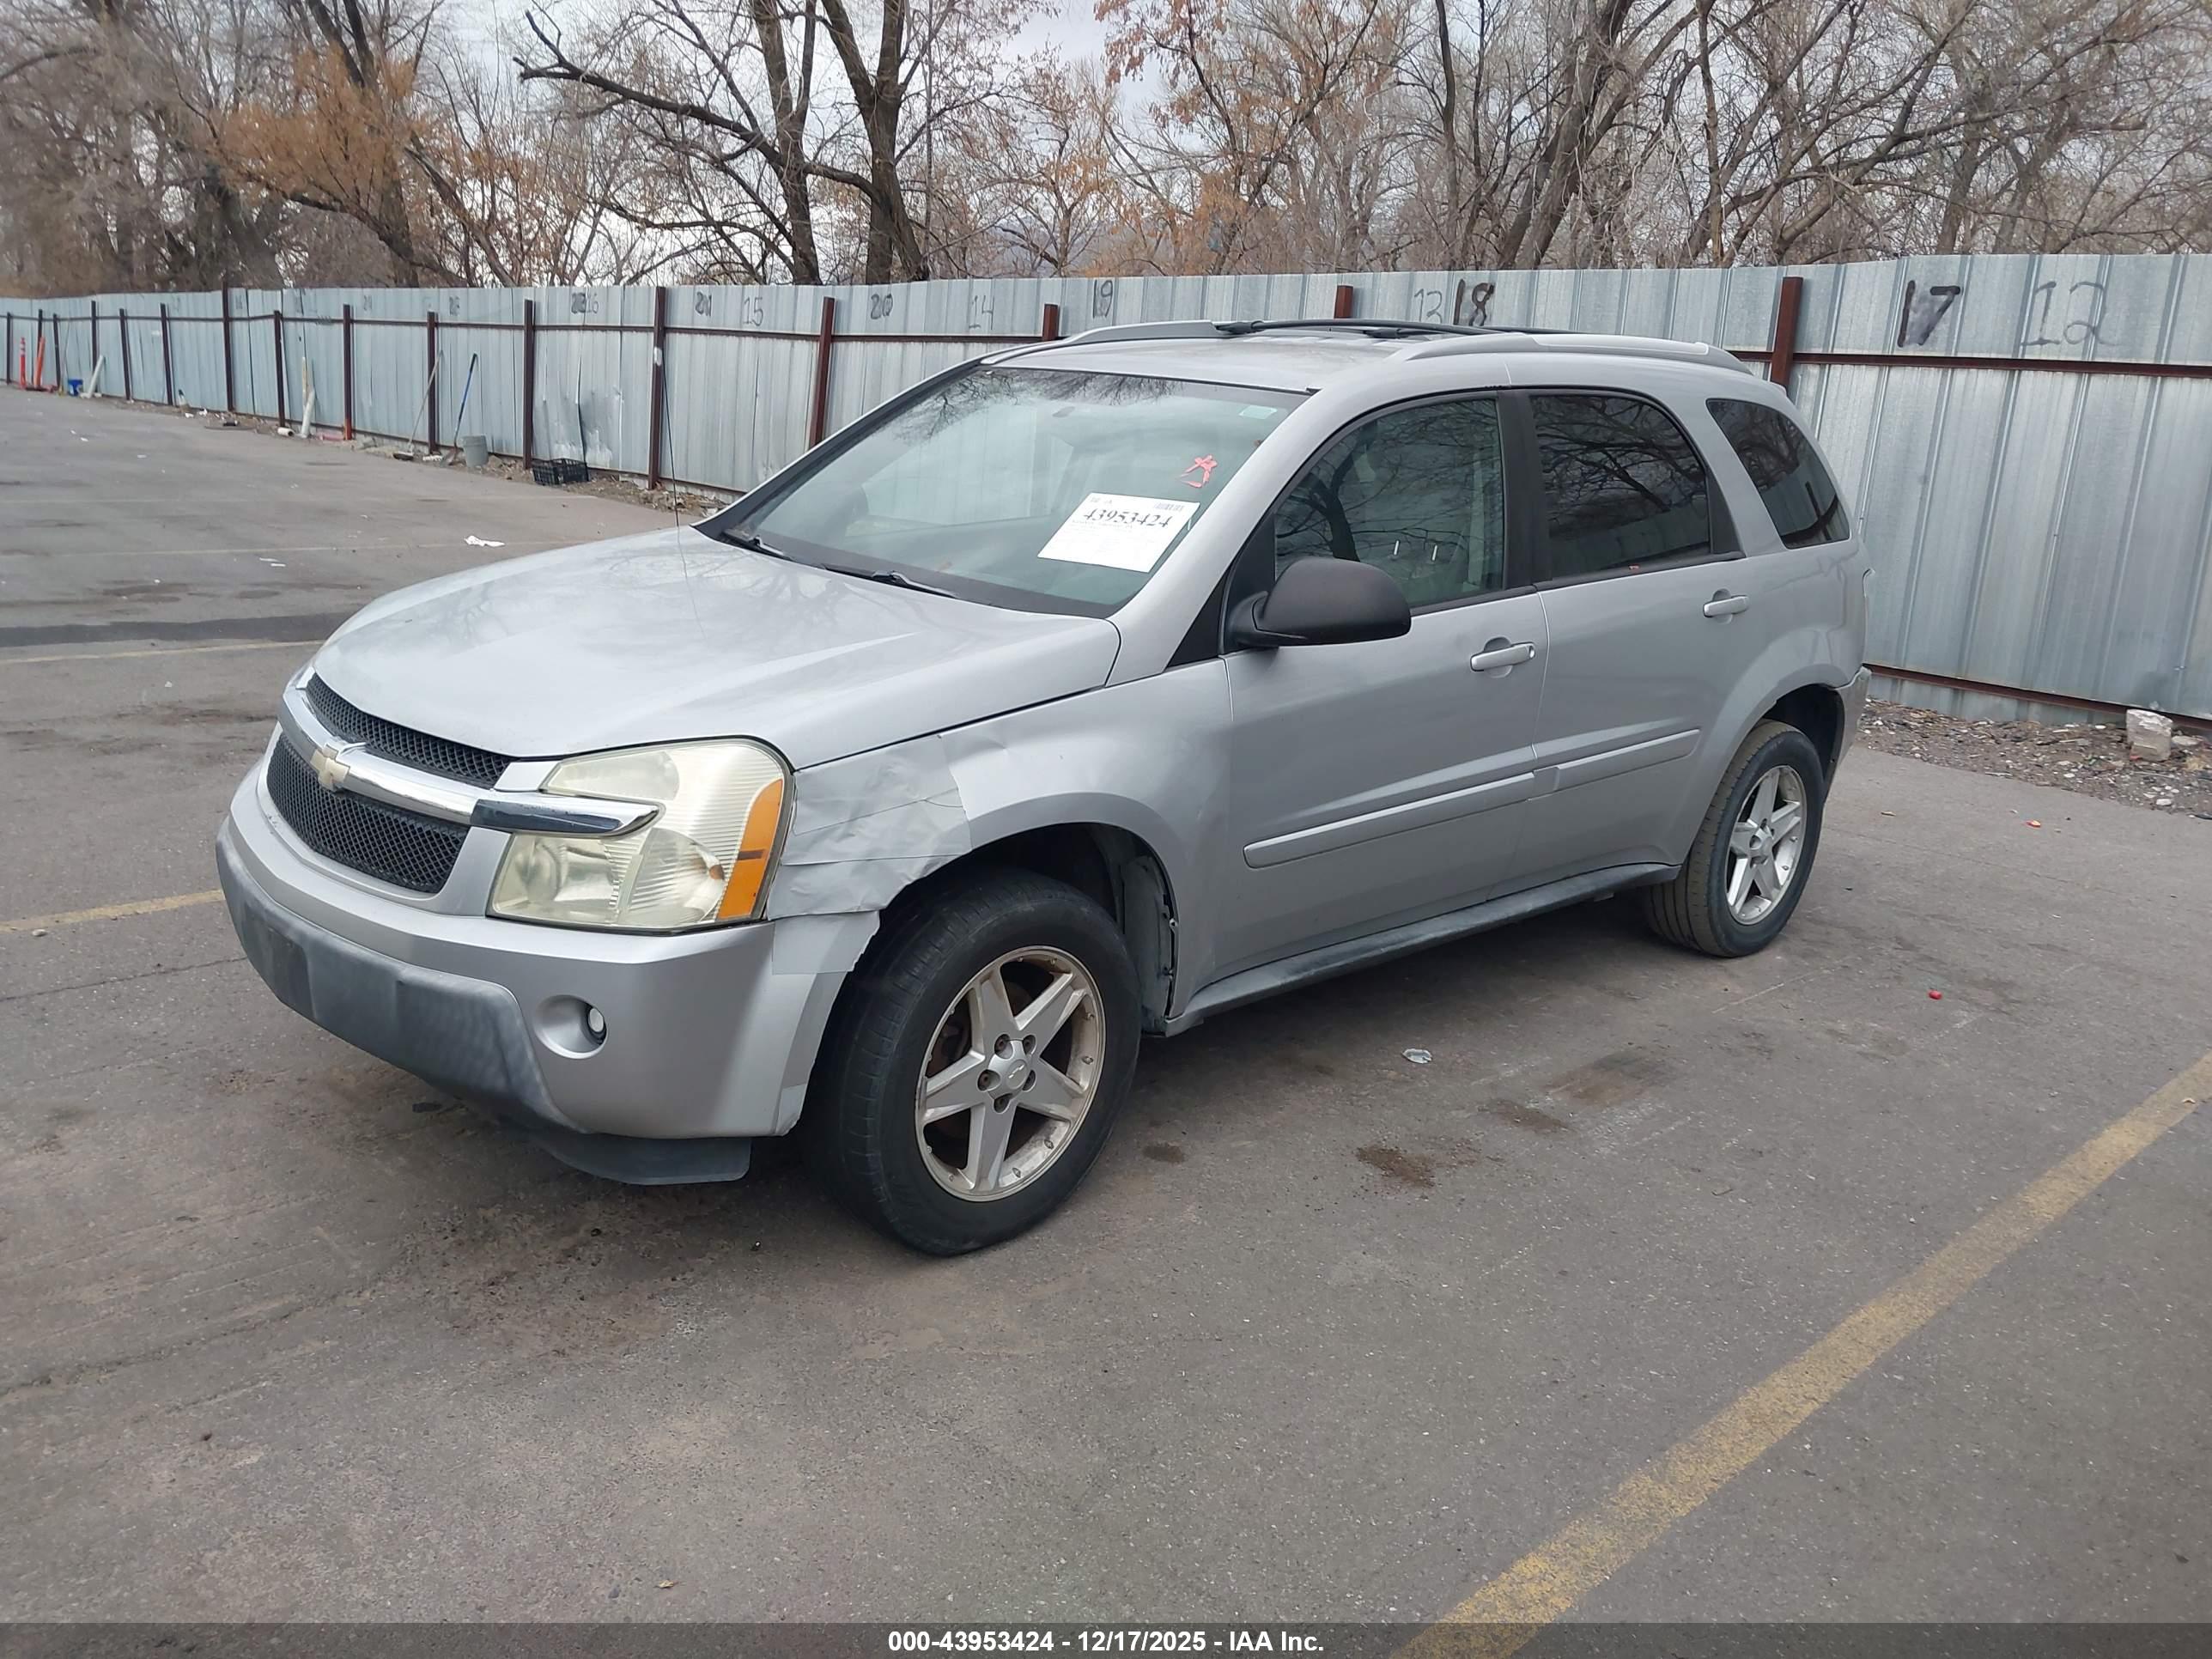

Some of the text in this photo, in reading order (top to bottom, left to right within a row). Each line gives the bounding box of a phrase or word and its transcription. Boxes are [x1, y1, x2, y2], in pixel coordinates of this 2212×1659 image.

[743, 296, 763, 326] 15
[969, 295, 995, 331] 14
[1092, 279, 1114, 319] 19
[1453, 278, 1495, 326] 18
[1897, 279, 1961, 347] 17
[2021, 280, 2118, 347] 12
[1083, 507, 1173, 528] 43953424
